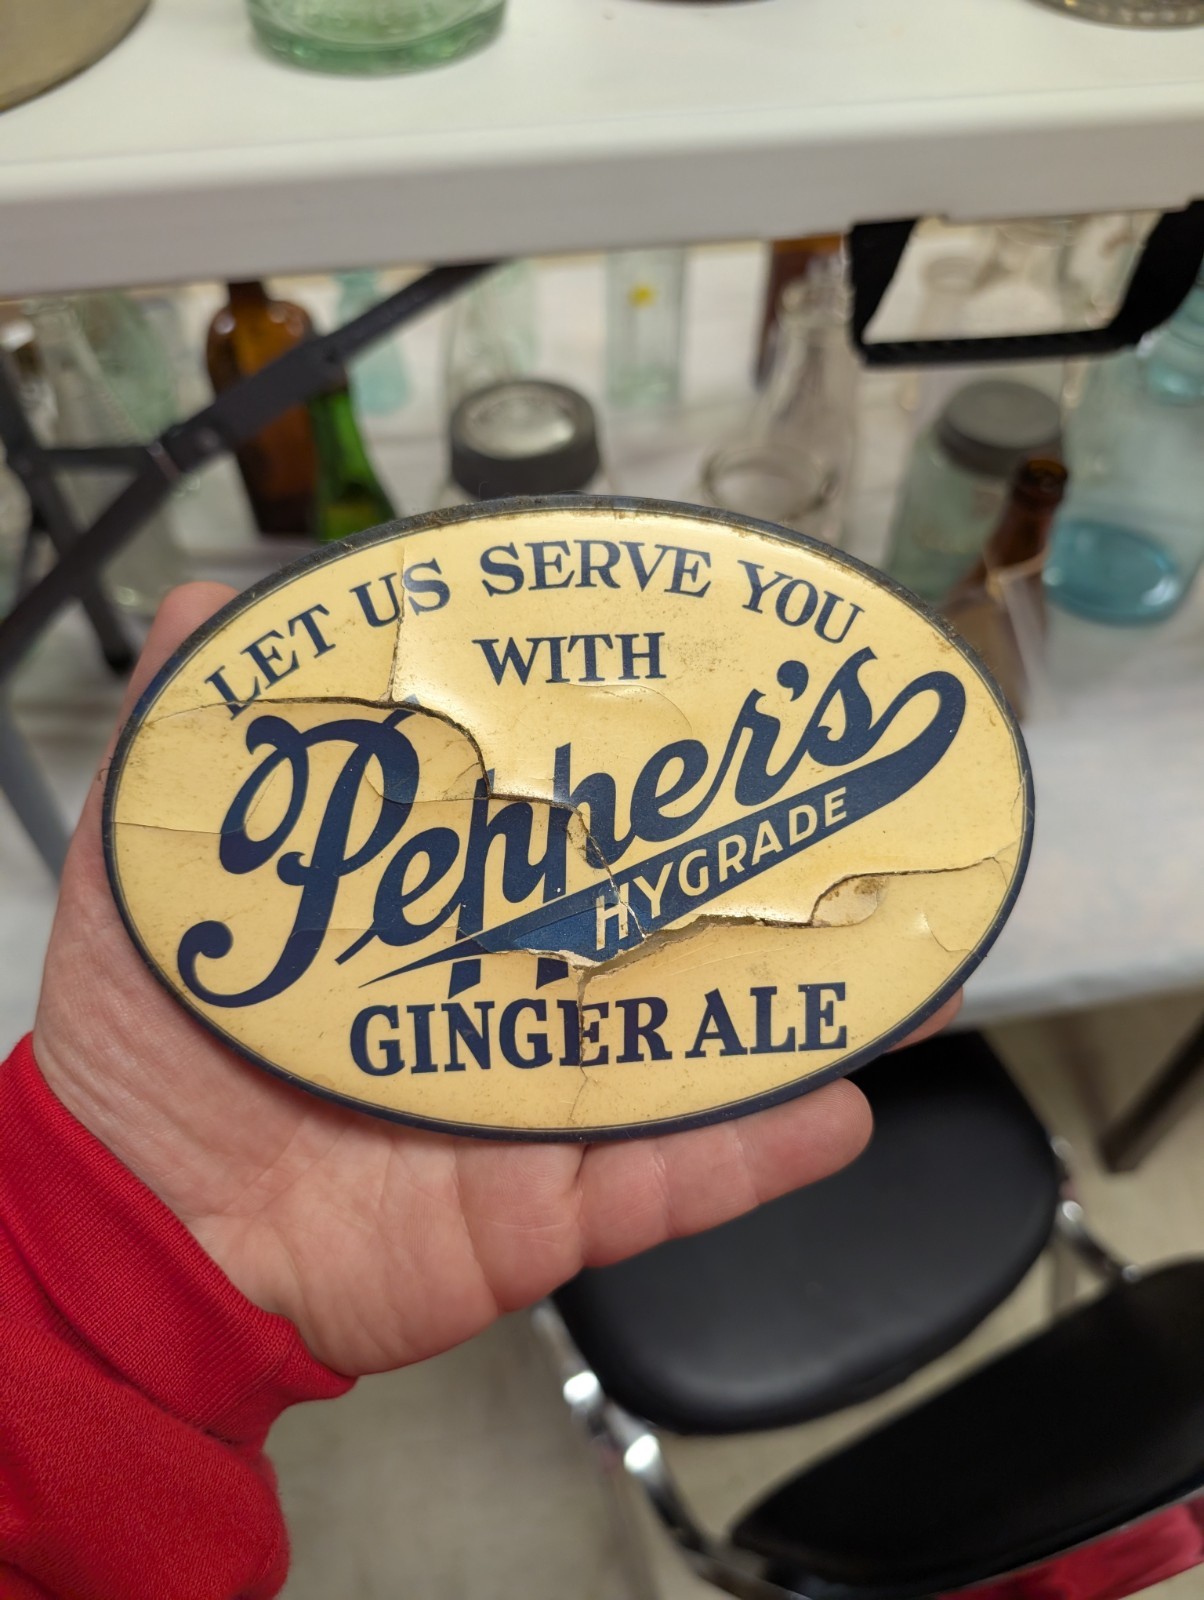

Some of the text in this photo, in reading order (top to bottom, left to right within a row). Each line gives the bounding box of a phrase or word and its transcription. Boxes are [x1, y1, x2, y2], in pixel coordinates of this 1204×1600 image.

[204, 539, 865, 721] LET US SERVE YOU
[472, 631, 668, 687] WITH
[177, 646, 967, 1008] Pepper's
[595, 786, 848, 951] HYGRADE
[349, 982, 847, 1077] GINGER ALE
